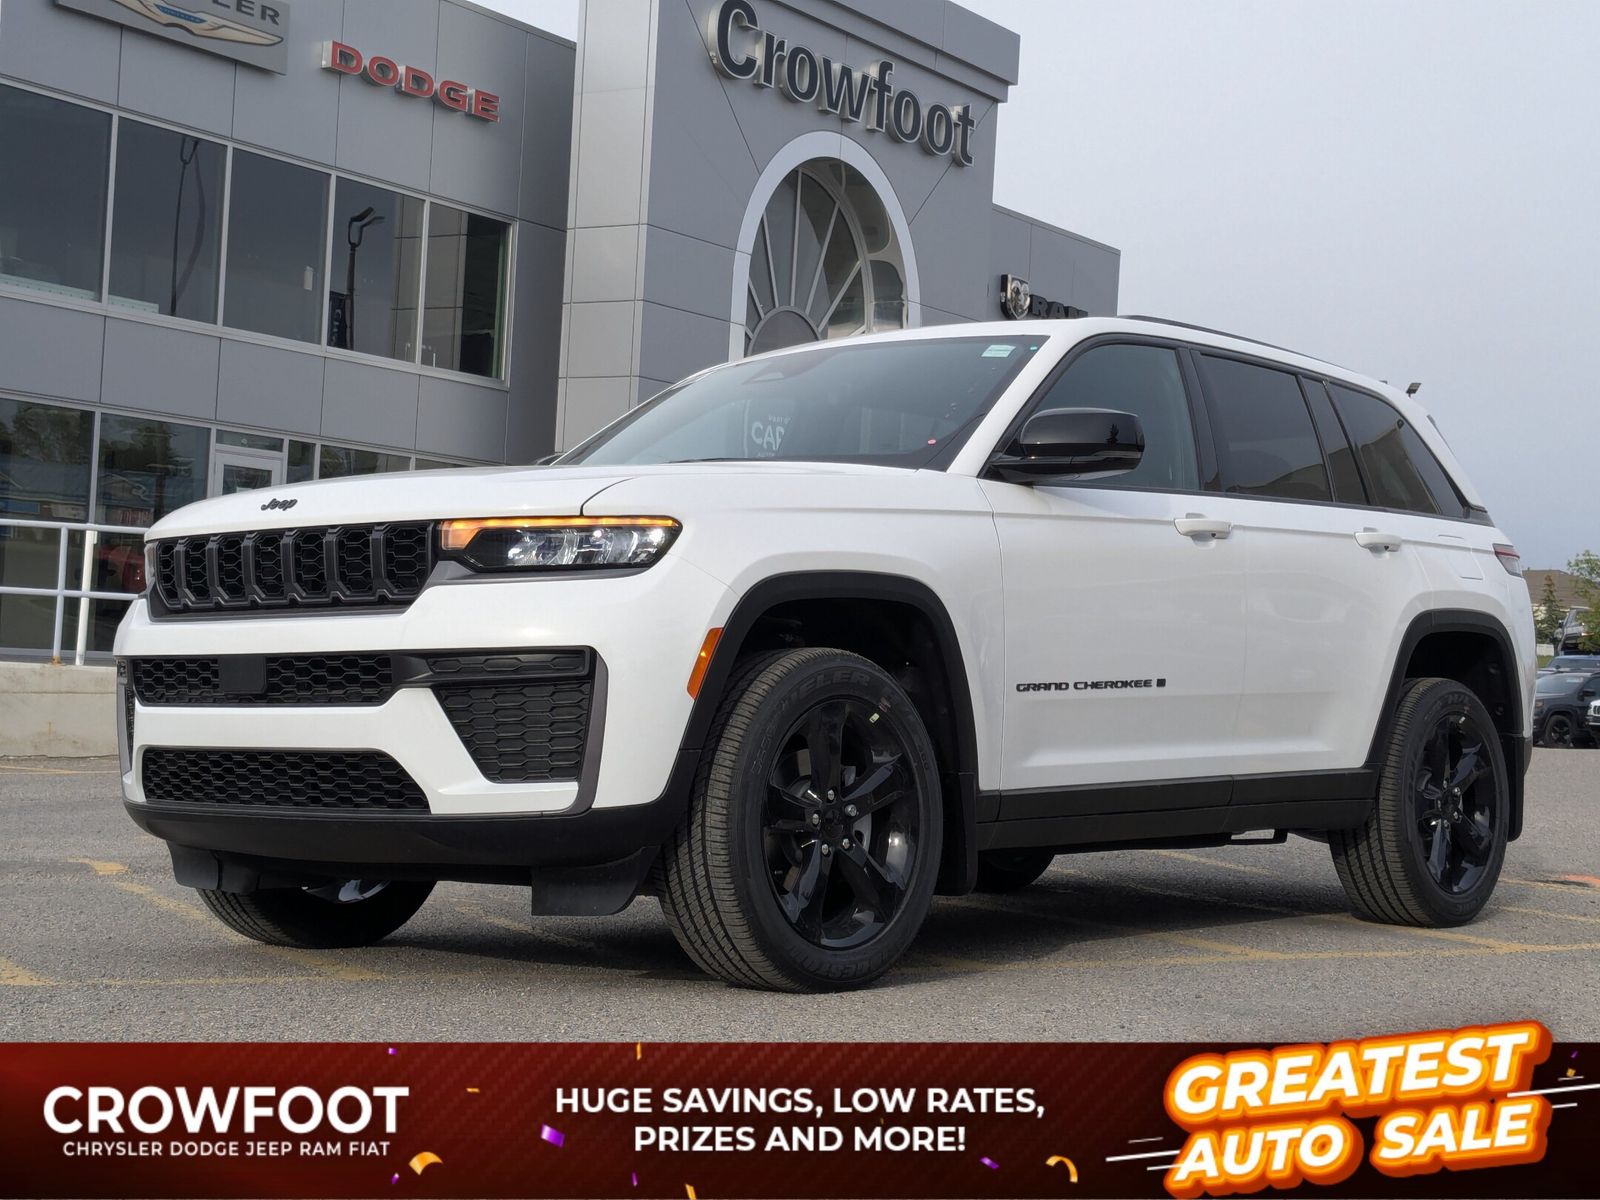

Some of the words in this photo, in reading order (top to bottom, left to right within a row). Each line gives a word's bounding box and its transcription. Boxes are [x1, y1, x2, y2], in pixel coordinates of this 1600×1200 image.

[323, 39, 500, 124] DODGE
[708, 0, 977, 167] Crowfoot
[260, 497, 298, 512] Jeep
[1015, 681, 1070, 693] GRAND
[1073, 678, 1153, 691] CHEROKEE
